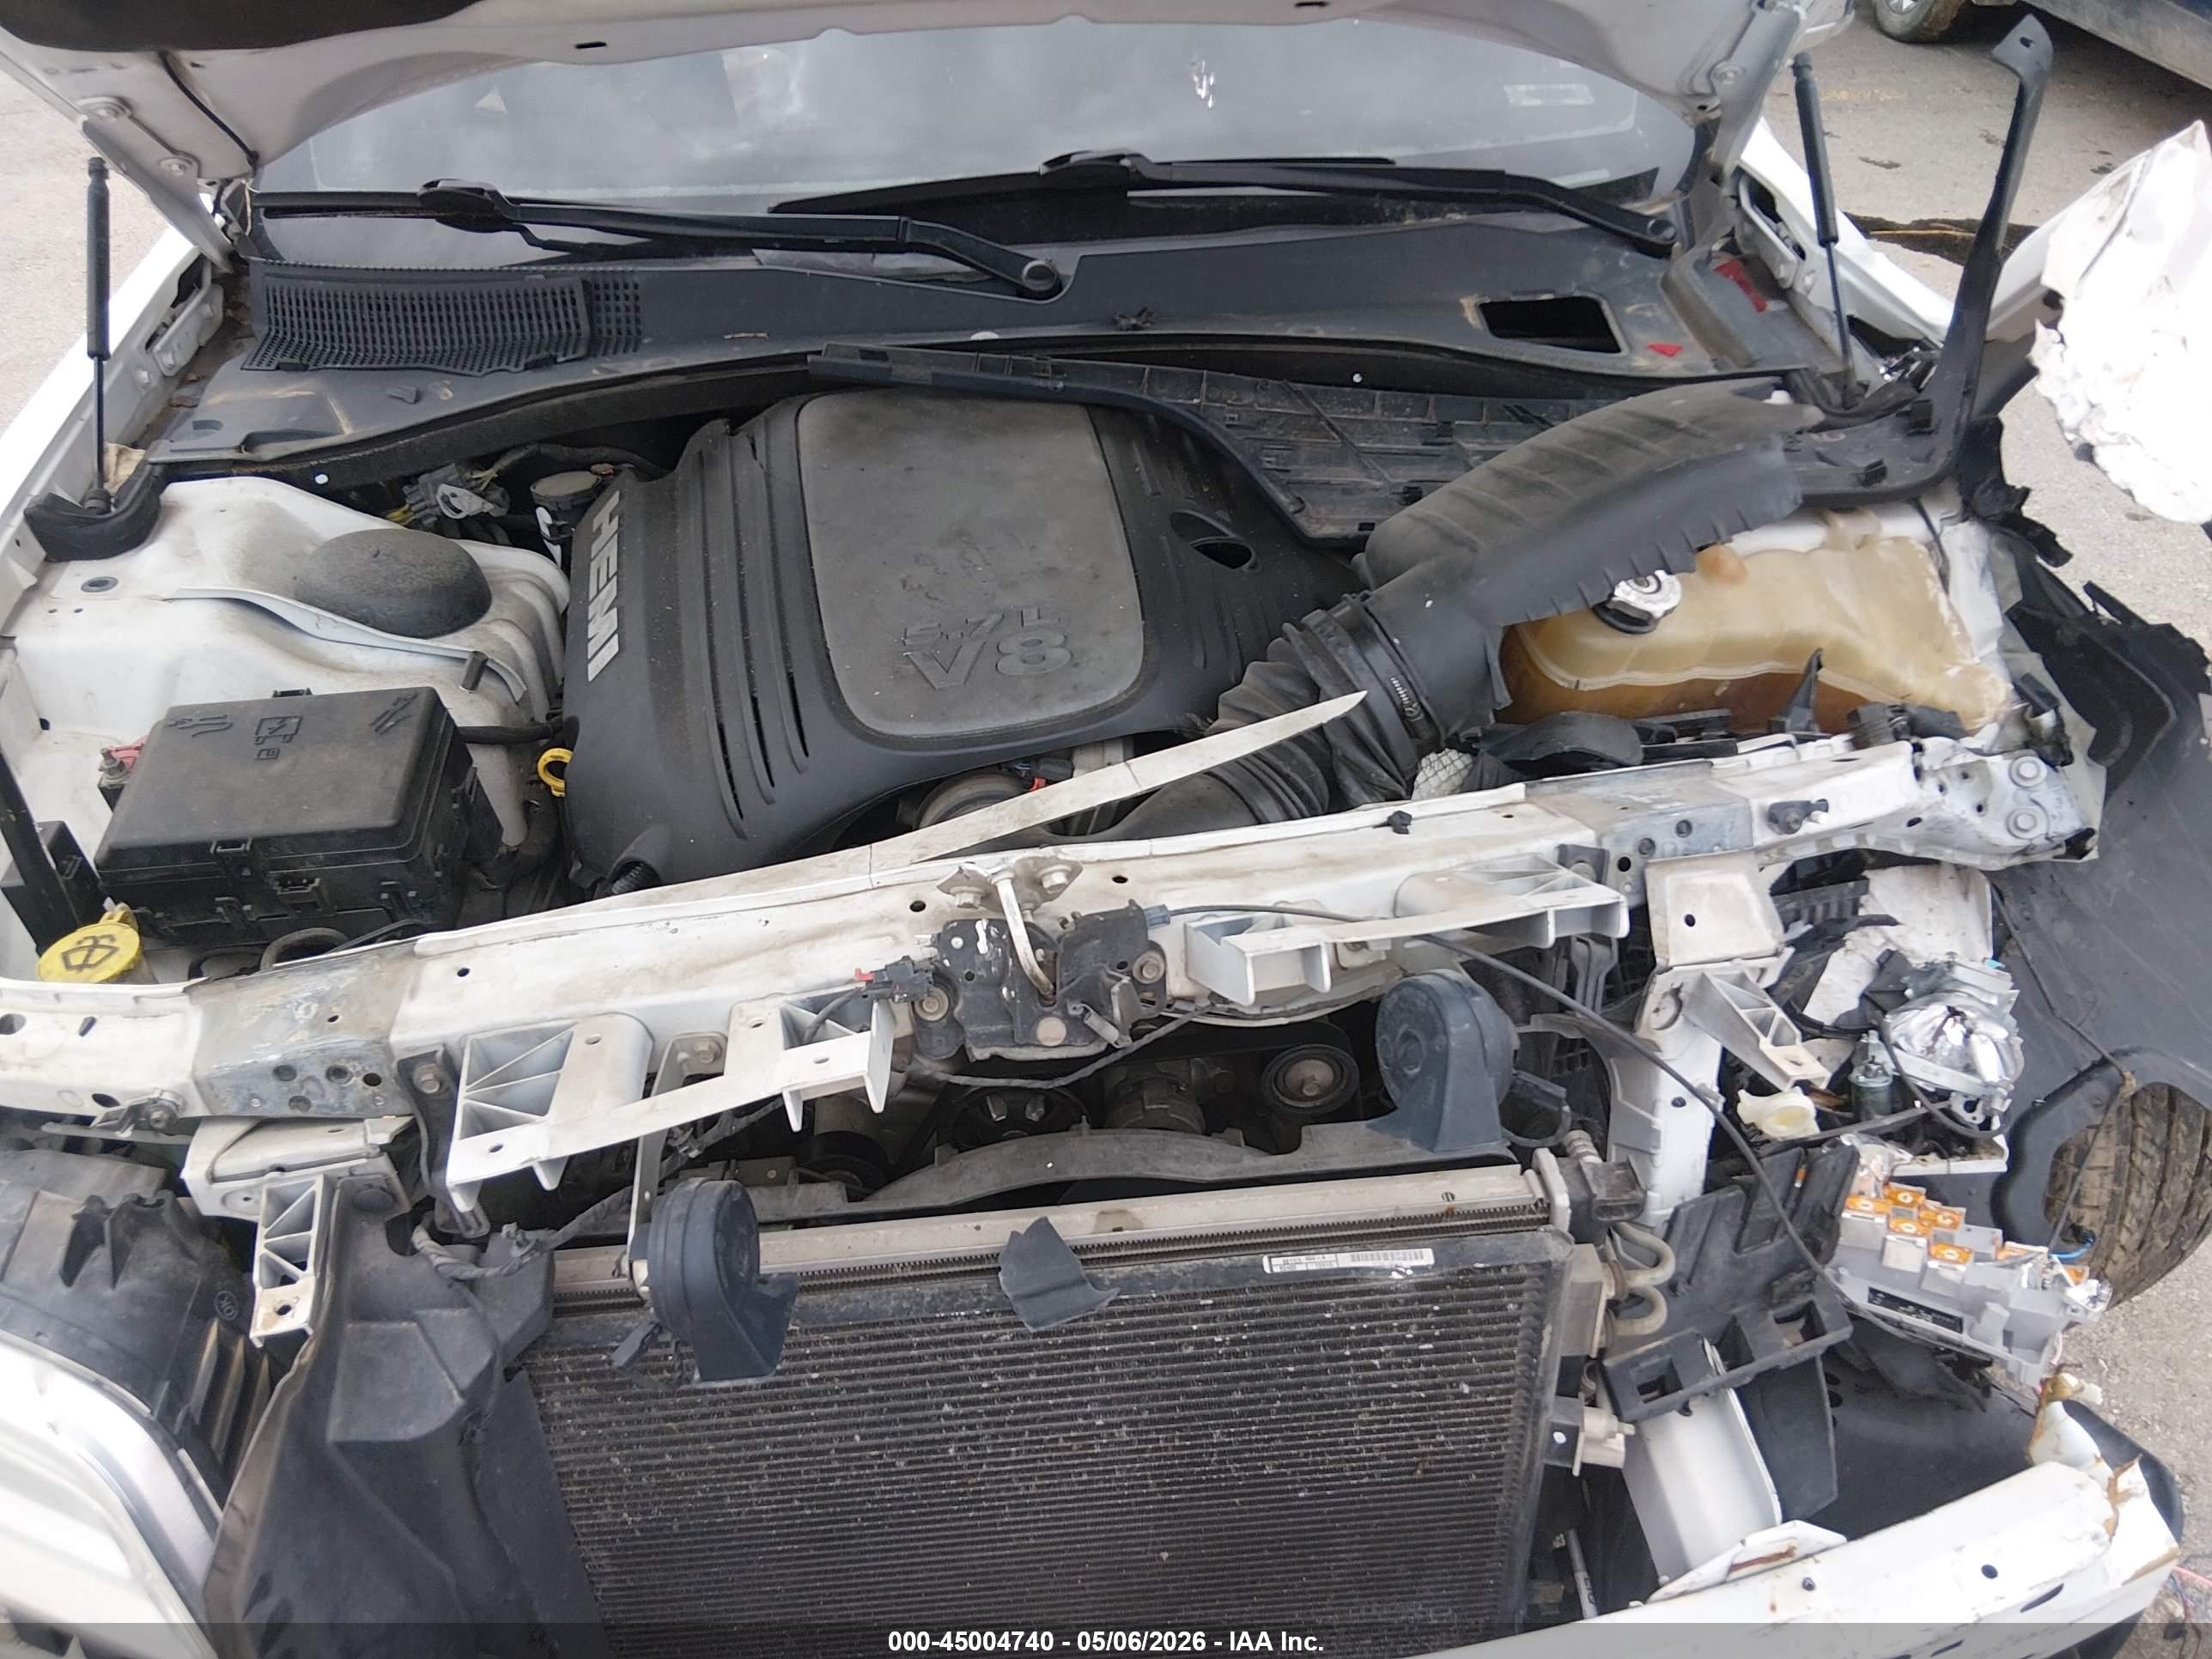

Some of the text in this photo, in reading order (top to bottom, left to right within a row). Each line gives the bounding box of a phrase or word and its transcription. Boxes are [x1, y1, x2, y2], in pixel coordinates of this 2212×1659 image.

[587, 490, 620, 683] HEMI
[902, 605, 1061, 646] 5.7L
[902, 629, 1073, 690] V8
